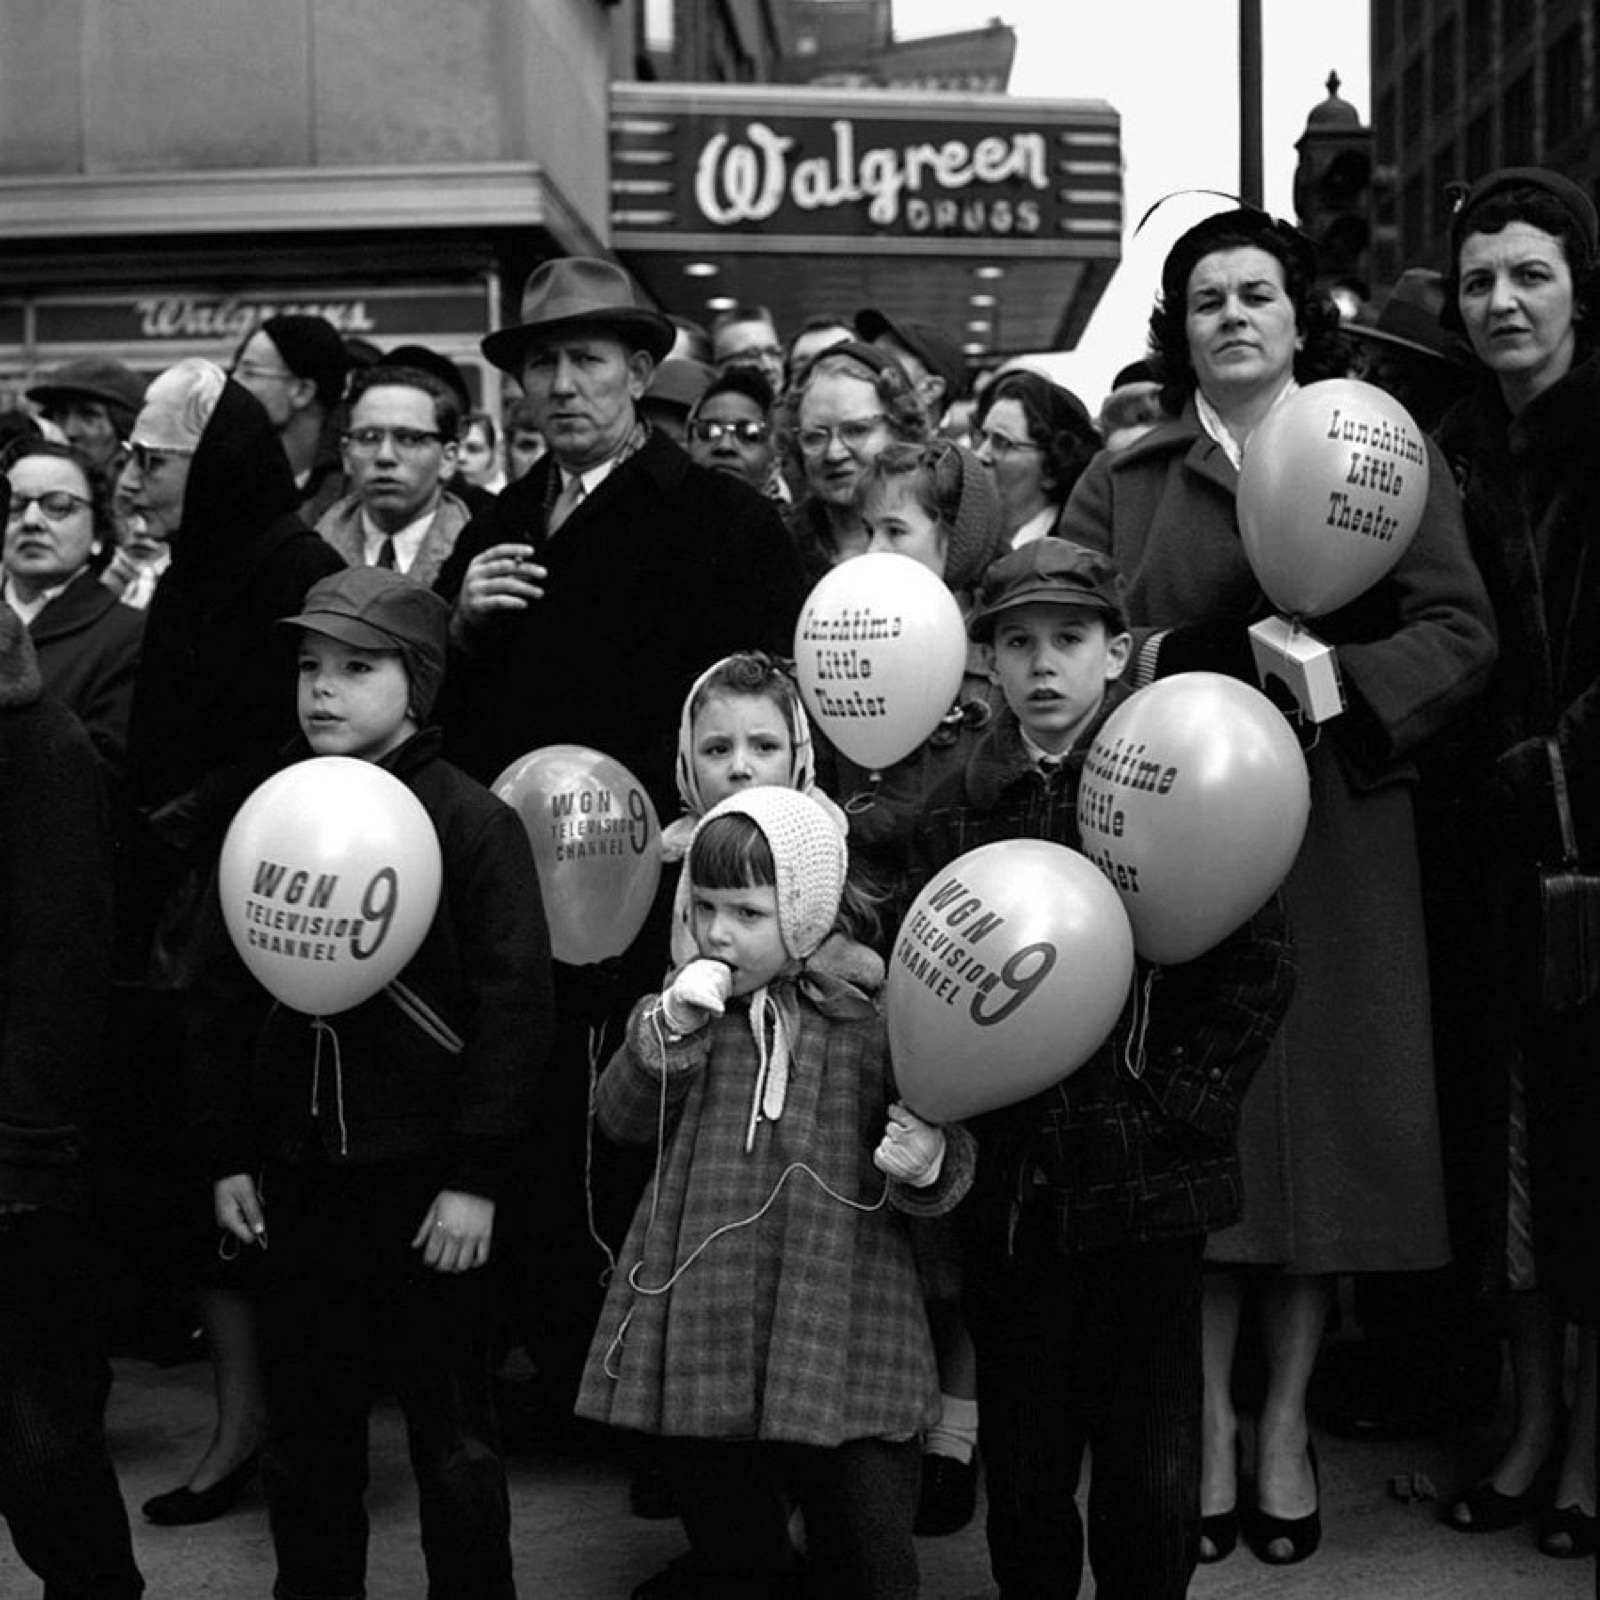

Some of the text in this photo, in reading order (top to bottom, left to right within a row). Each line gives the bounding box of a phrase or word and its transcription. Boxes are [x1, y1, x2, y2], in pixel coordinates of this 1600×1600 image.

[695, 120, 1049, 225] Walgreen
[906, 200, 1042, 233] DRUGS
[1346, 453, 1403, 496] Little
[1326, 491, 1398, 541] Theater
[816, 649, 872, 680] Little
[551, 818, 636, 838] TELEVISION
[552, 790, 611, 818] WGN
[629, 788, 648, 855] 9
[556, 839, 623, 862] CHANNEL
[252, 861, 338, 909] WGN
[246, 901, 364, 938] TELEVISION
[350, 866, 398, 960] 9
[928, 877, 1005, 945] WGN
[247, 928, 337, 962] CHANNEL
[909, 909, 1001, 994] TELEVISION
[897, 937, 961, 1005] CHANNEL
[969, 941, 1057, 1027] 9
